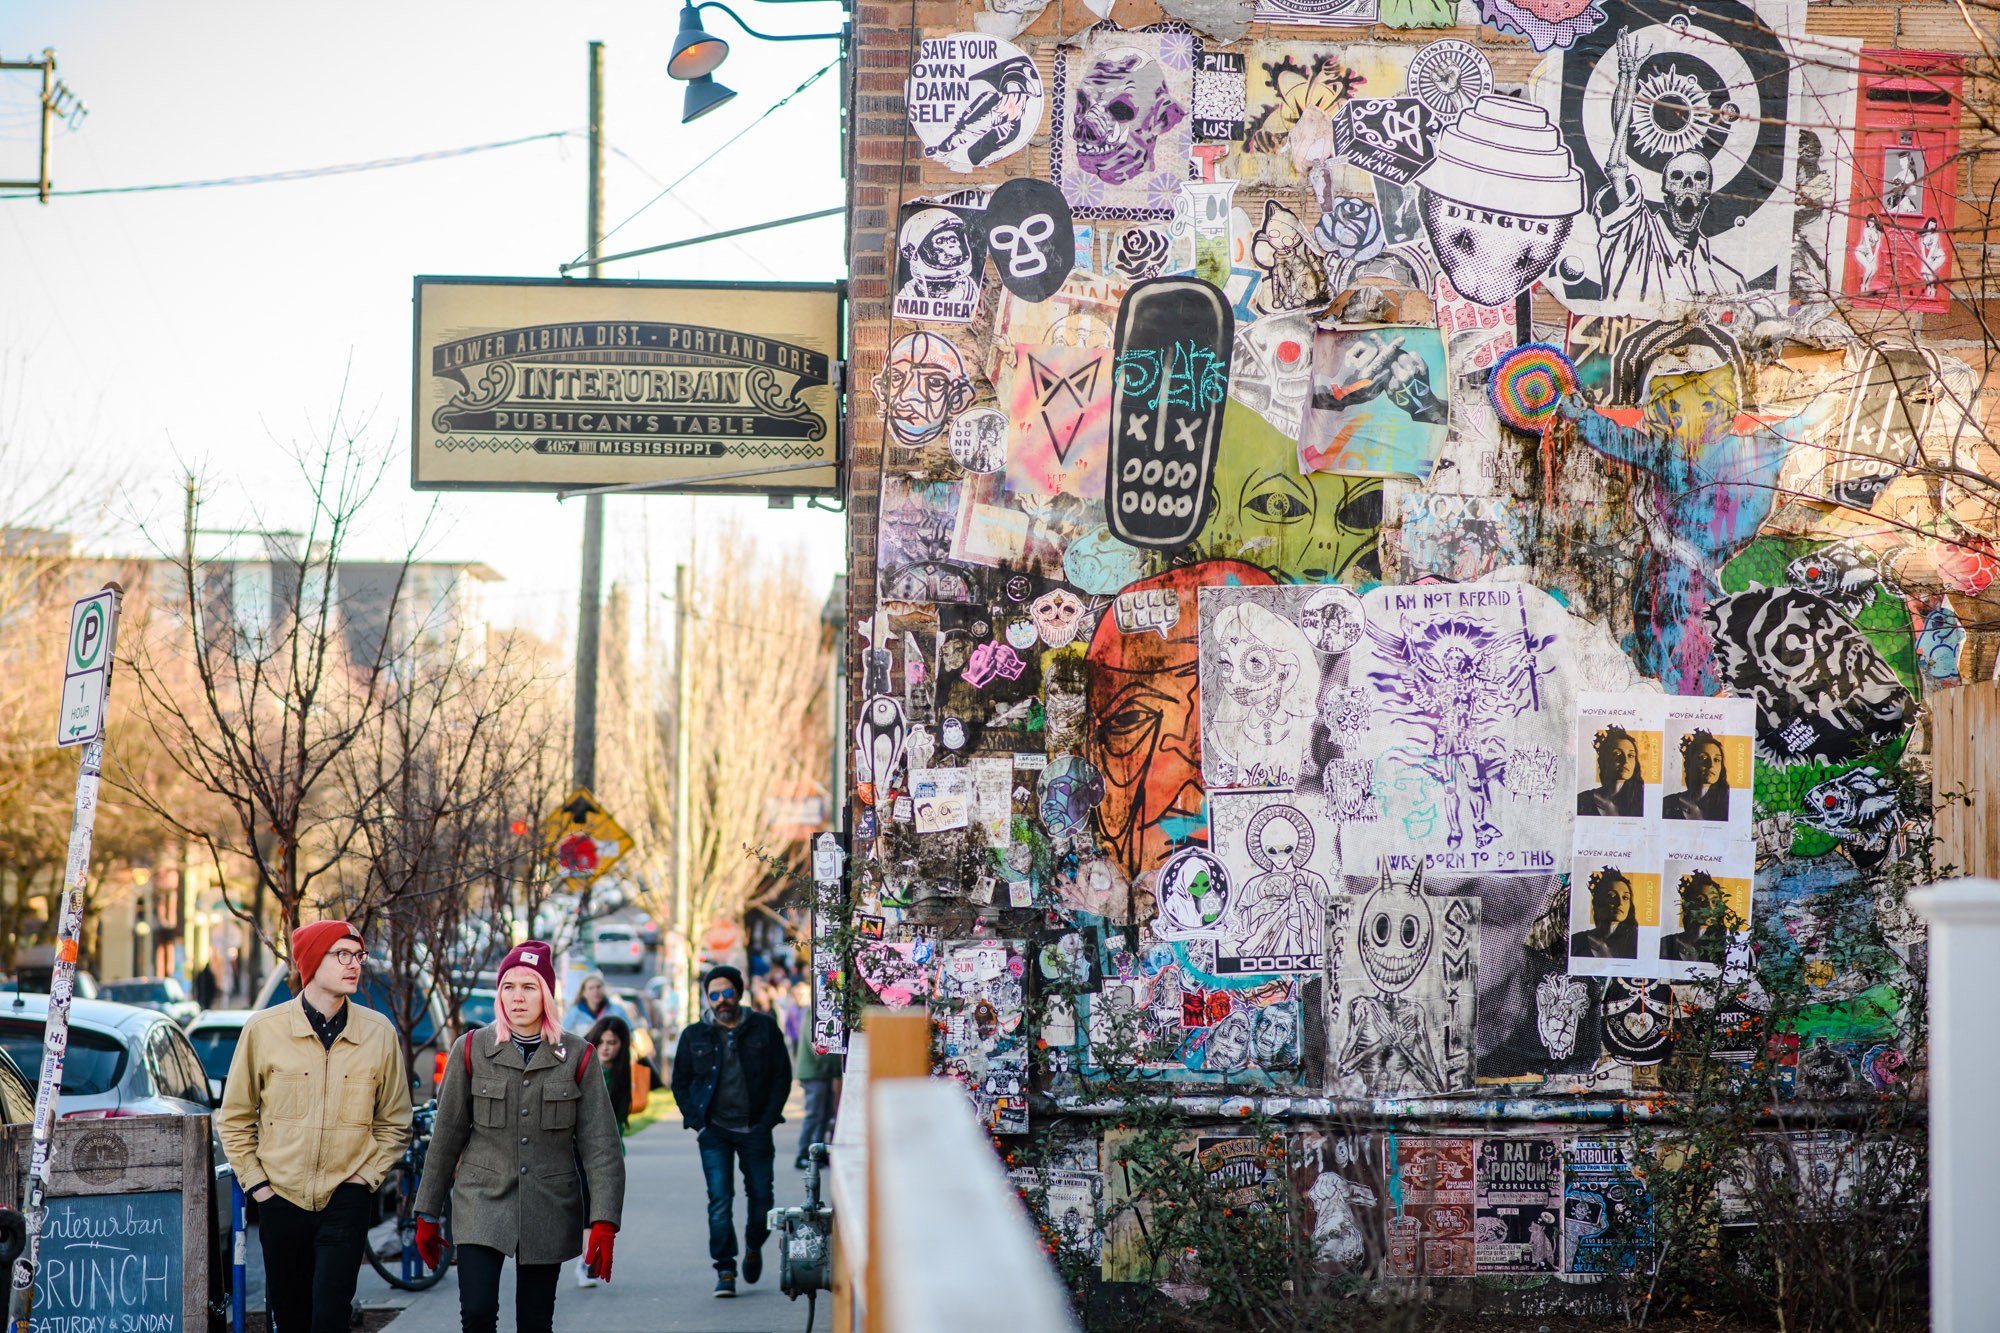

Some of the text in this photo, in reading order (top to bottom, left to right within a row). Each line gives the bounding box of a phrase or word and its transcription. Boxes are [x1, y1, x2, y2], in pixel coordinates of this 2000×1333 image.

[922, 40, 998, 60] SAVE YOUR
[1411, 41, 1454, 75] CHOSEN
[1458, 41, 1487, 66] FEW
[912, 64, 965, 78] OWN
[1203, 54, 1237, 73] PILL
[916, 82, 970, 100] DAMN
[909, 104, 956, 122] SELF
[1347, 149, 1409, 182] UNKNWN
[1371, 149, 1397, 164] PRTS
[1445, 203, 1551, 236] DINGUS
[896, 299, 975, 318] MAD CHEA
[444, 336, 505, 368] LOWER
[516, 326, 585, 353] ALBINA
[596, 325, 641, 346] DIST.
[669, 328, 766, 361] PORTLAND
[777, 346, 819, 376] ORE.
[516, 366, 743, 404] INTERURBAN
[495, 412, 755, 434] PUBLICAN'S TABLE
[544, 440, 577, 453] 4057
[599, 441, 712, 455] MISSISSIPPI
[1396, 594, 1416, 610] AM
[1459, 591, 1511, 607] AFRAID
[81, 615, 99, 656] P
[80, 681, 86, 703] 1
[70, 705, 89, 720] HOUR
[1582, 708, 1636, 716] WOVEN ARCANE
[1668, 711, 1723, 720] WOVEN ARCANE
[1736, 743, 1745, 785] CREATE YOU
[1471, 851, 1489, 868] TO
[1521, 850, 1555, 866] THIS
[1577, 849, 1632, 858] WOVEN ARCANE
[1668, 852, 1723, 862] WOVEN ARCANE
[953, 962, 974, 973] SUN
[1720, 1011, 1745, 1023] PRTS
[50, 1031, 65, 1046] Hi.
[45, 1057, 56, 1079] UNION
[41, 1085, 50, 1096] BE
[39, 1096, 48, 1106] TO
[35, 1106, 46, 1130] PROUD
[1409, 1139, 1441, 1147] SKULS
[1503, 1142, 1532, 1161] RAT
[1491, 1161, 1546, 1181] POISON
[28, 1314, 106, 1333] SATURDAY
[122, 1313, 174, 1332] SUNDAY
